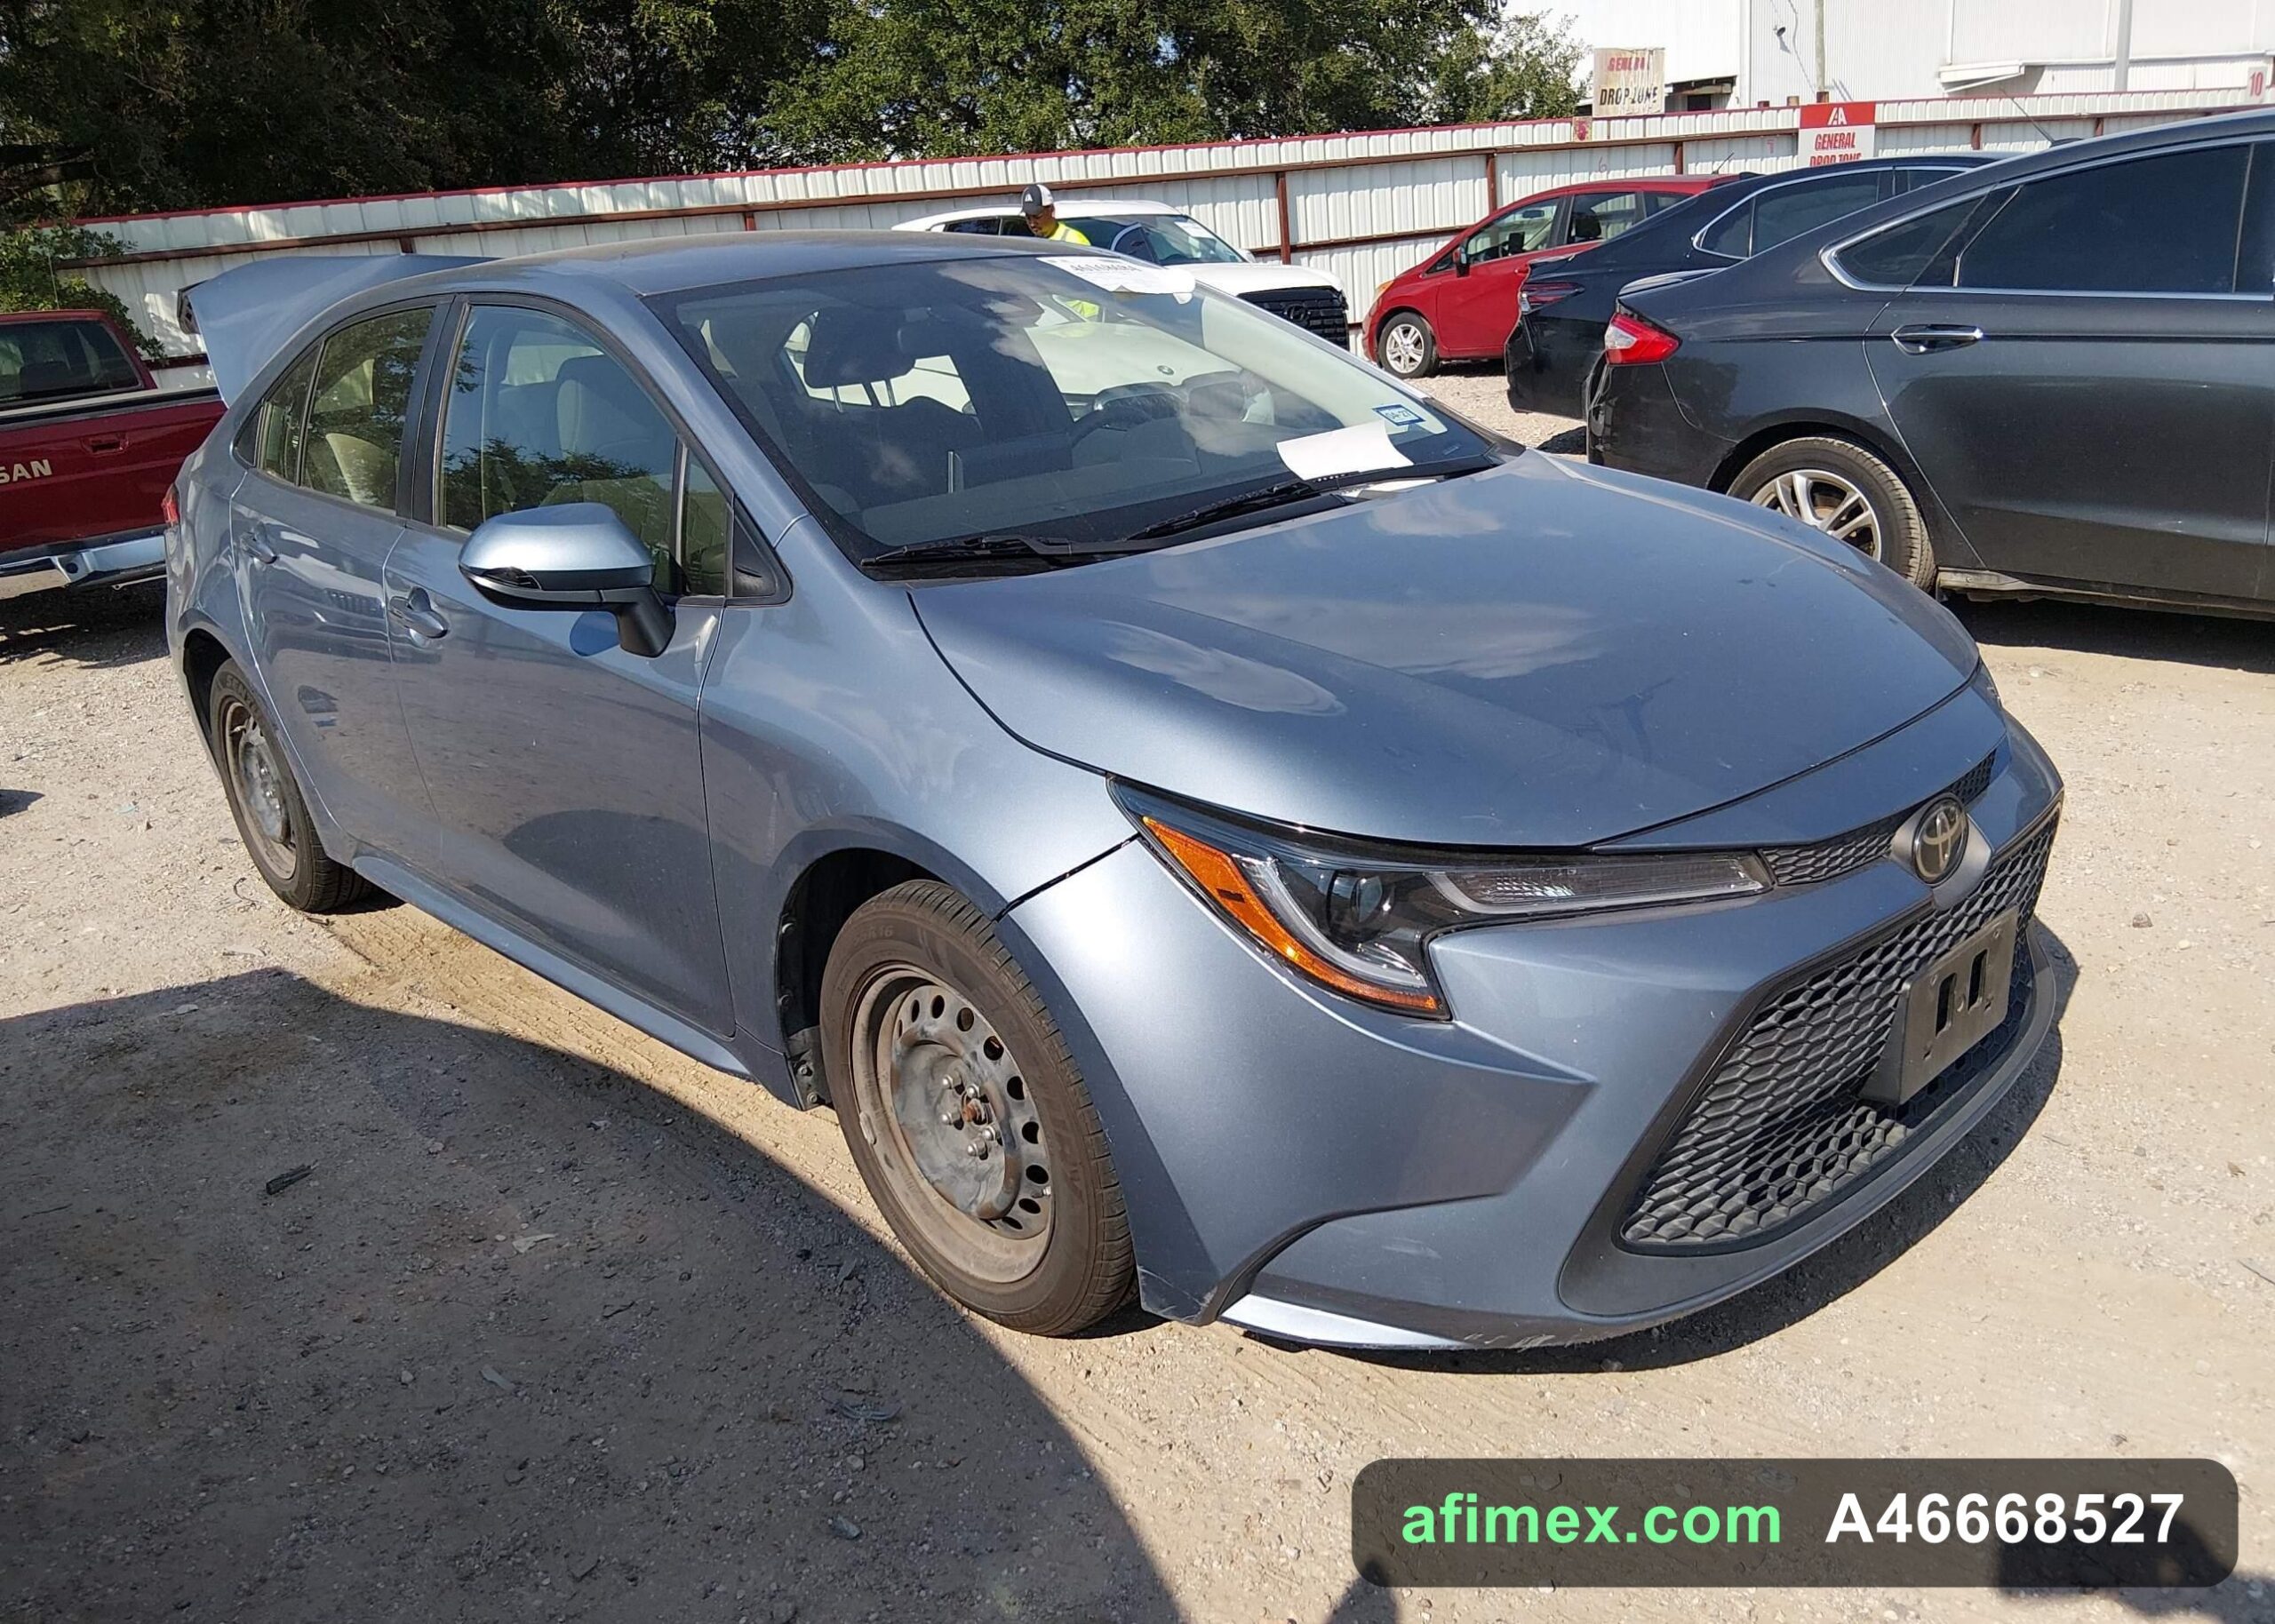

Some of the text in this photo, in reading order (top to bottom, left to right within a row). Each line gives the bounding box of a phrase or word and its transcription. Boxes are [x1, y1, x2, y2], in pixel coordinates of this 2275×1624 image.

[2249, 71, 2263, 96] 10
[1600, 87, 1630, 106] DROP
[1815, 131, 1856, 151] GENERAL
